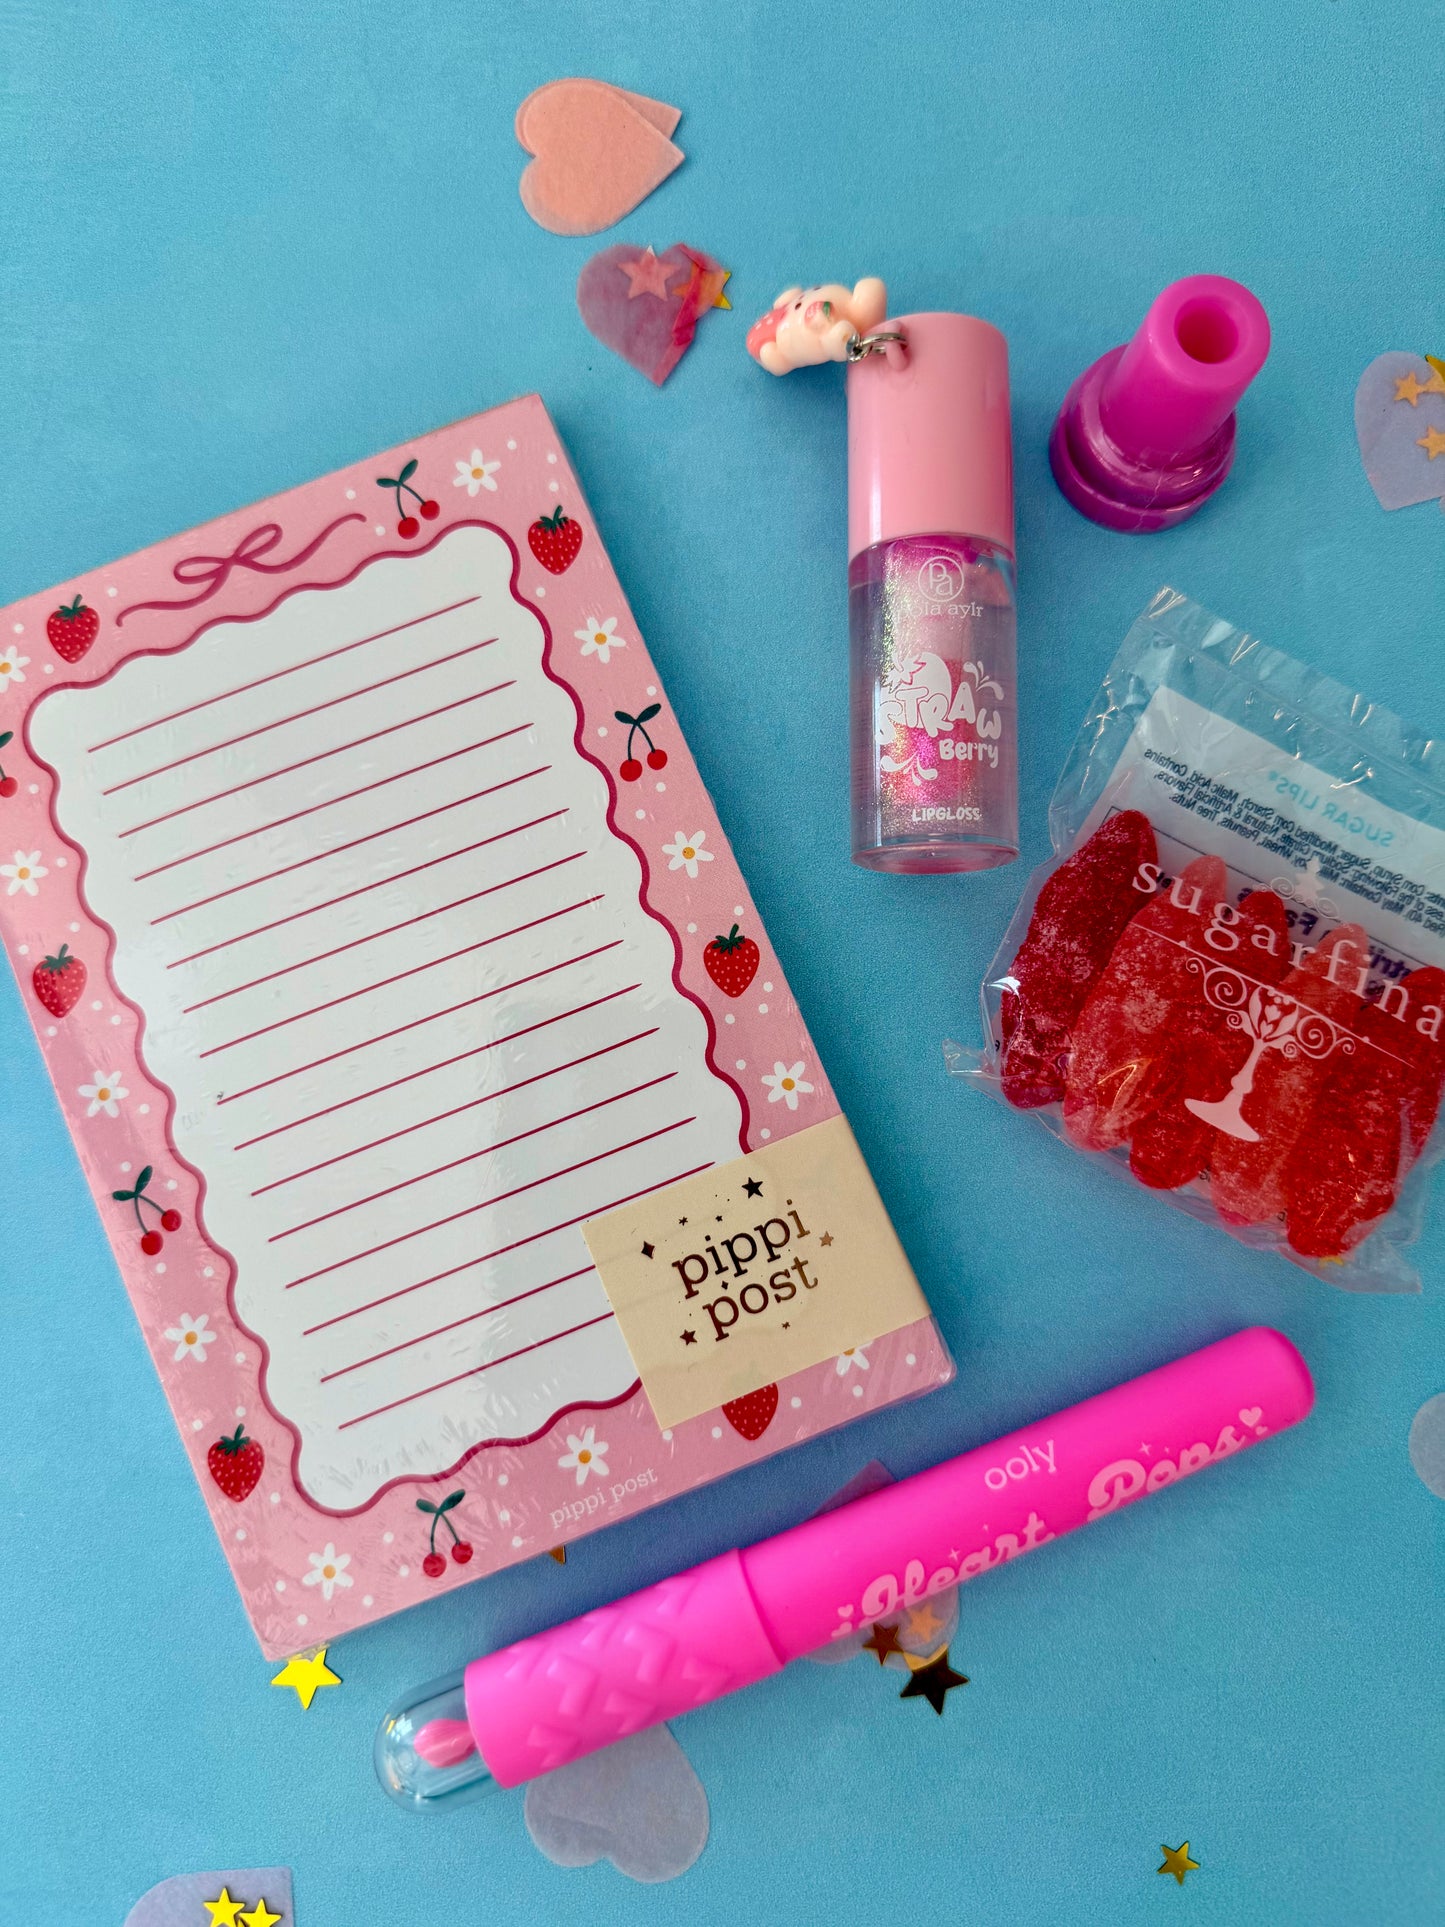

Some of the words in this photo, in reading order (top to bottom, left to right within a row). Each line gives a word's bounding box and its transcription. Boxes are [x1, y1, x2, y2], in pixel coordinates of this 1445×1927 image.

[875, 681, 1002, 745] STRAW
[939, 738, 999, 769] Berry
[911, 807, 981, 823] LIPGLOSS
[1131, 862, 1444, 1043] sugarfina
[671, 1198, 812, 1300] pippi
[702, 1255, 820, 1342] post
[549, 1479, 607, 1528] pippi
[609, 1465, 659, 1502] post
[983, 1440, 1057, 1491] ooly
